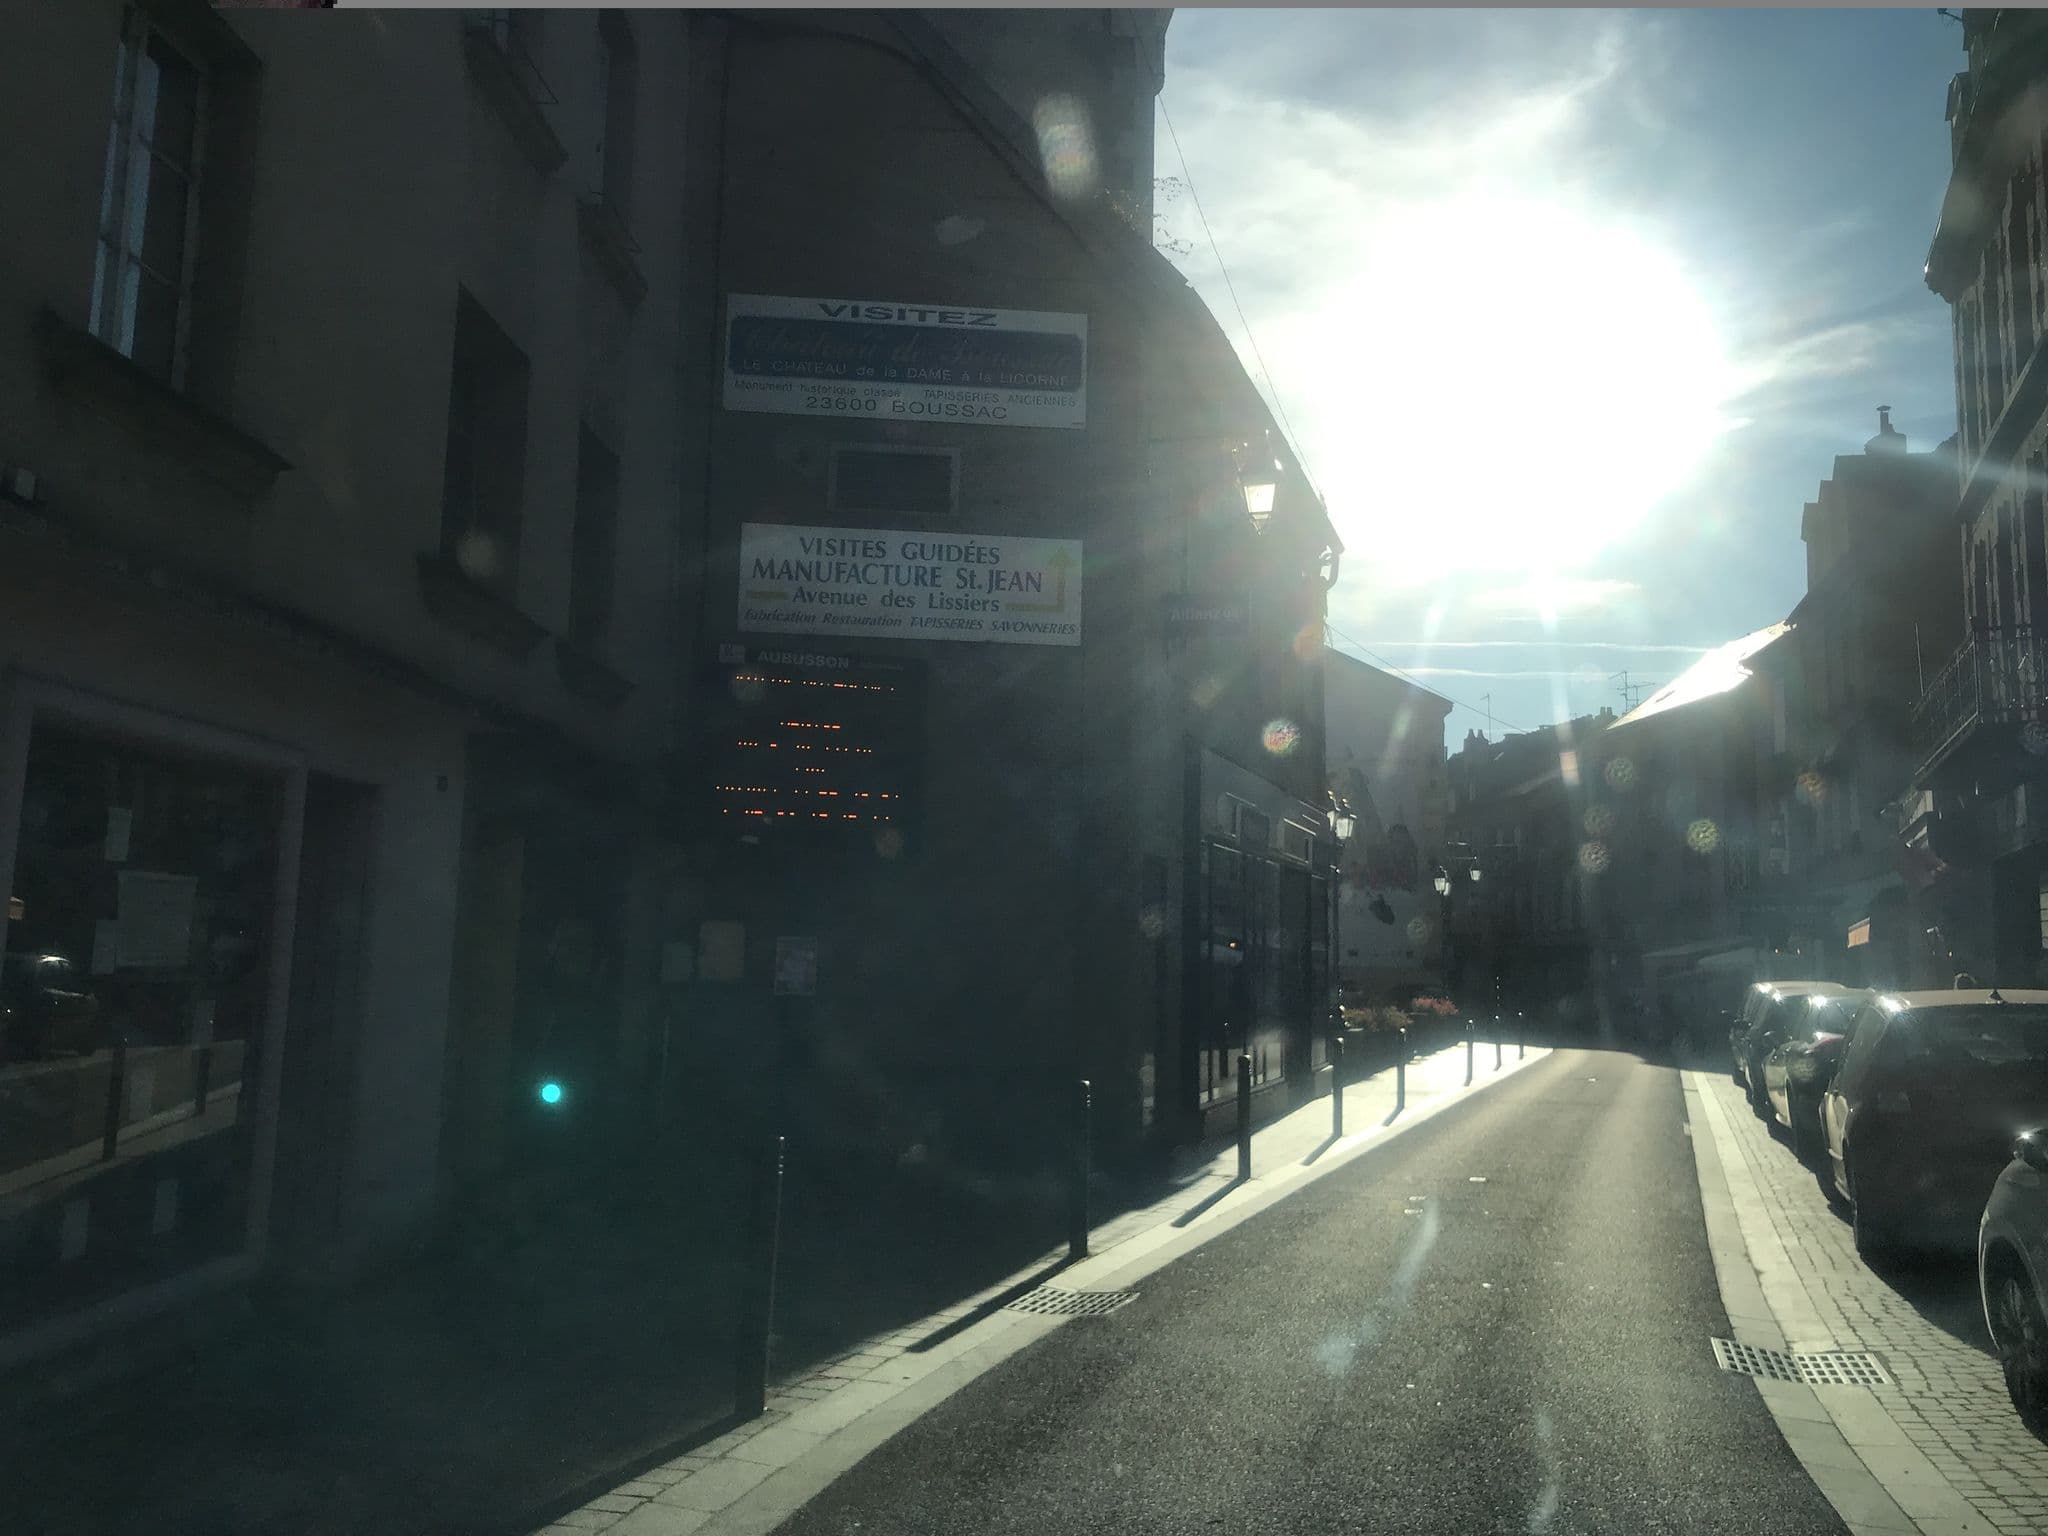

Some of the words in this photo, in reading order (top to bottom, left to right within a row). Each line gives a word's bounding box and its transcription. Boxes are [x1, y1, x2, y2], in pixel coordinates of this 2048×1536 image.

[818, 303, 998, 327] VISITEZ
[883, 366, 897, 378] la
[806, 396, 877, 412] 23600
[892, 399, 1008, 419] BOUSSAC
[923, 389, 1000, 404] TAPISSERIES
[1008, 395, 1077, 408] ANCIENNES
[799, 536, 887, 559] VISITES
[901, 540, 1000, 566] GUIDÉES
[752, 558, 942, 588] MANUFACTURE
[792, 586, 868, 608] Avenue
[881, 590, 916, 608] des
[928, 592, 1000, 613] Lissiers
[823, 611, 903, 628] Restauration
[910, 615, 983, 632] TAPISSERIES
[990, 620, 1077, 636] SAVONNERIES
[757, 650, 849, 669] AUBUSSON
